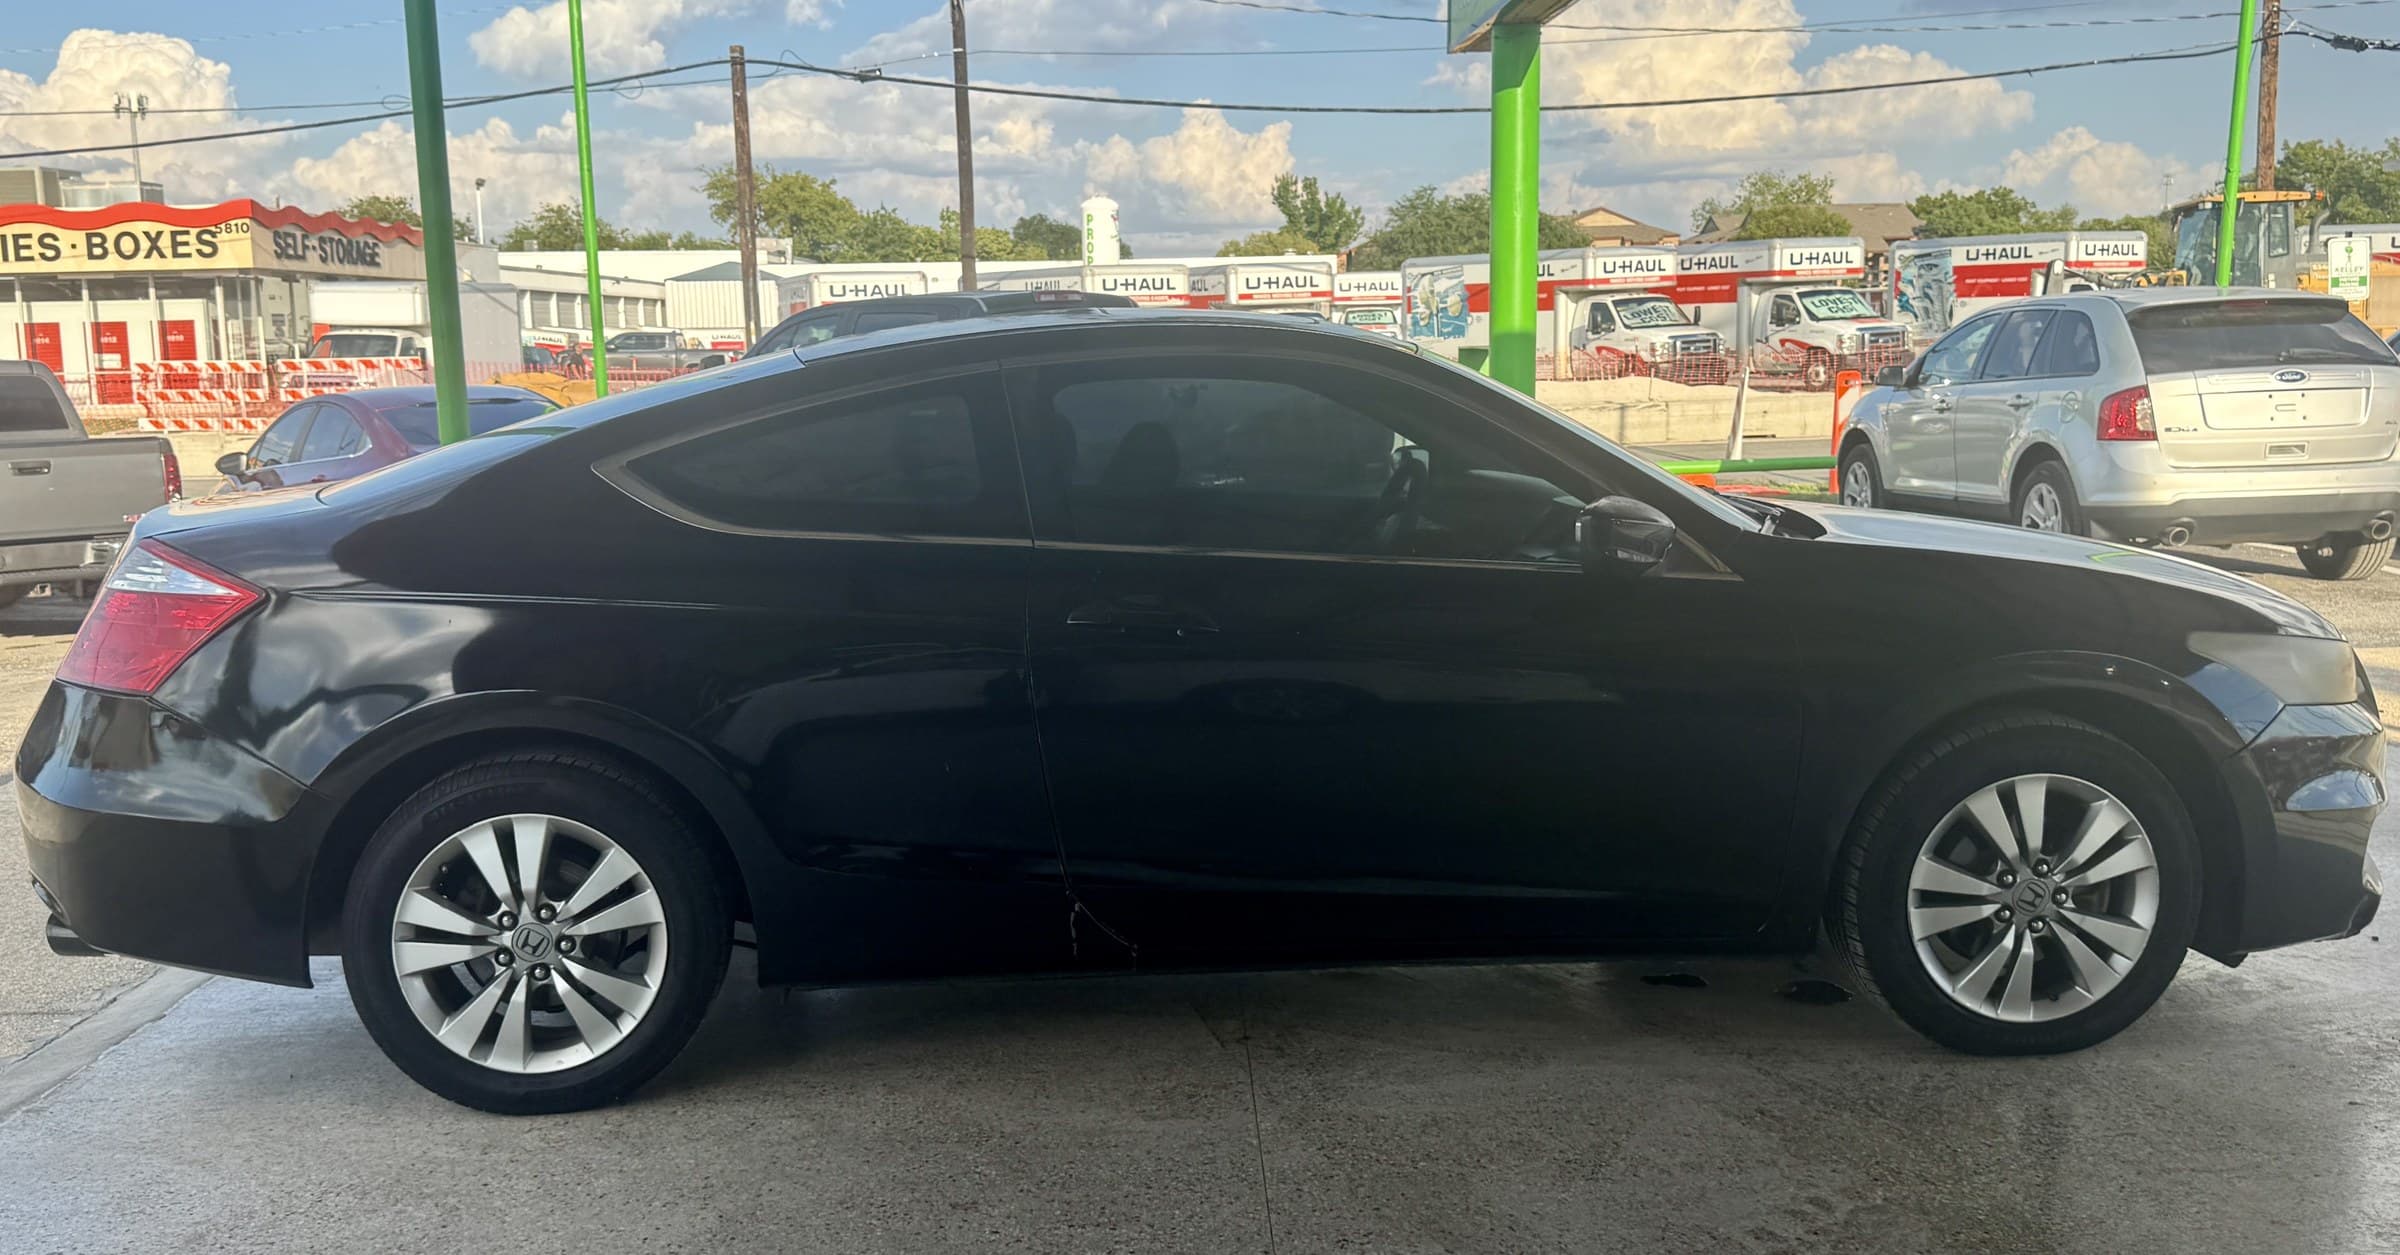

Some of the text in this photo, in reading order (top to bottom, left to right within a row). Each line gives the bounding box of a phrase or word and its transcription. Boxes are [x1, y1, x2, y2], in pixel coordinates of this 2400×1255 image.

[215, 222, 250, 234] 5810
[85, 229, 219, 260] BOXES
[2085, 244, 2138, 256] U-HAUL
[1790, 251, 1853, 266] U-HAUL
[1966, 246, 2033, 261] U-HAUL
[1604, 259, 1666, 274] U-HAUL
[1680, 255, 1739, 271] U-HAUL
[1102, 277, 1176, 291] U-HAUL
[1246, 275, 1320, 290] U-HAUL
[1339, 281, 1399, 292] U-HAUL
[829, 284, 912, 298] U-HAUL
